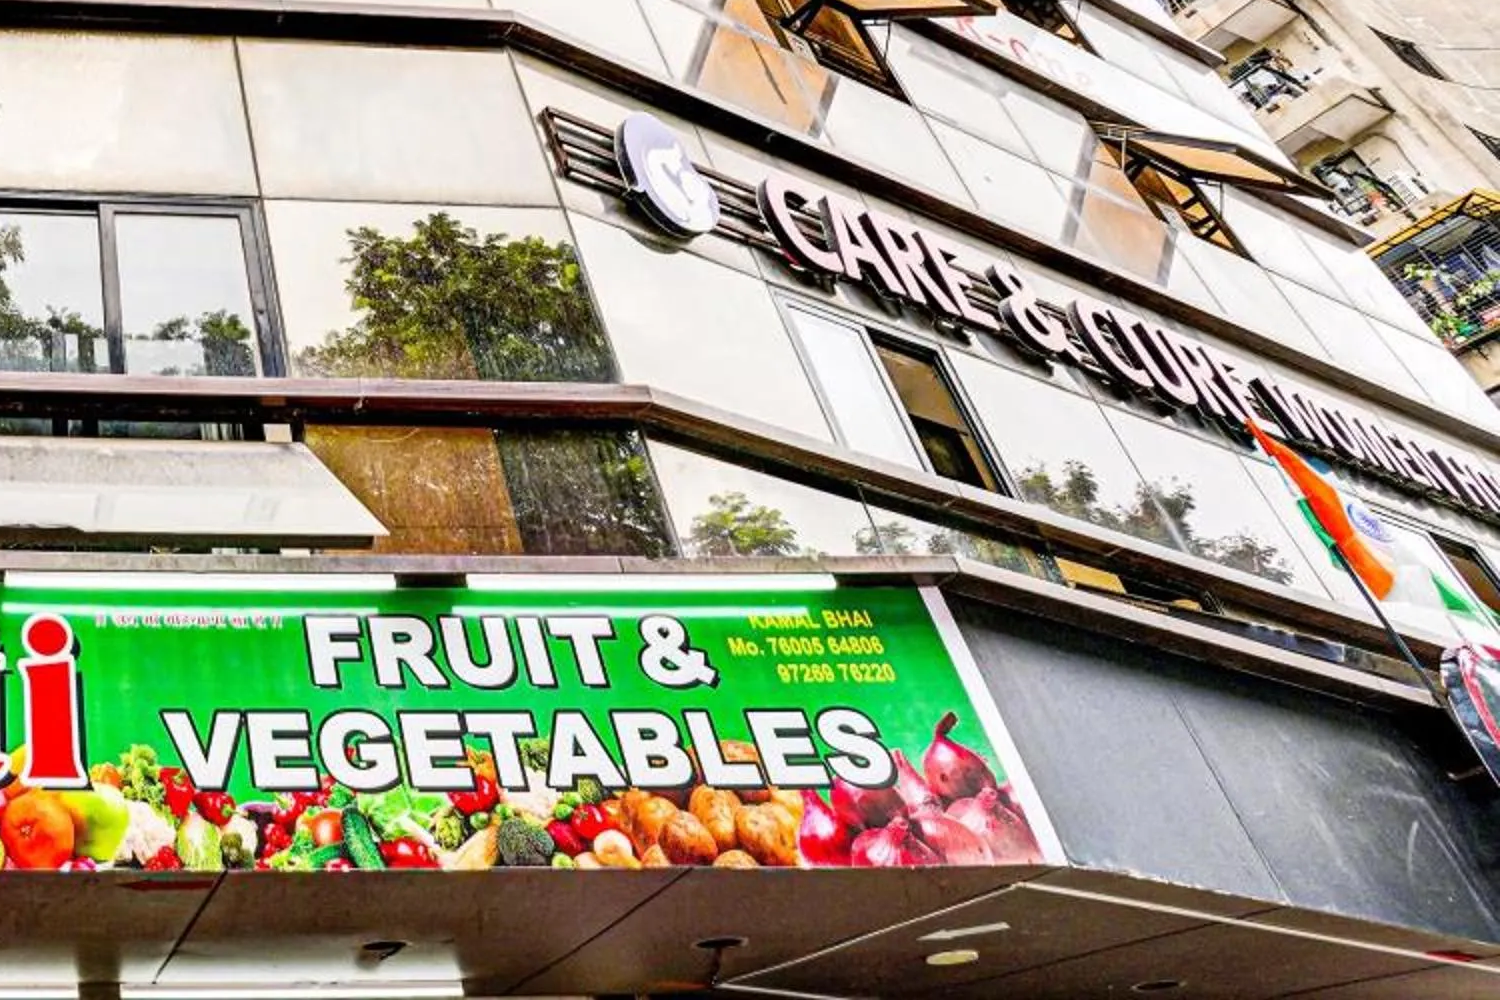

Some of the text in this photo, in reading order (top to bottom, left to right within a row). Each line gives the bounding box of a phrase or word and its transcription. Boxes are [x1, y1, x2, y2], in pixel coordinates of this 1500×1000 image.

[758, 172, 1002, 329] CARE
[986, 263, 1072, 360] &
[1067, 297, 1287, 441] CURE
[1257, 376, 1460, 499] WOMEN
[303, 613, 721, 690] FRUIT &
[726, 636, 766, 657] Mo.
[747, 609, 874, 629] KAMAL BHAI
[160, 708, 902, 794] VEGETABLES
